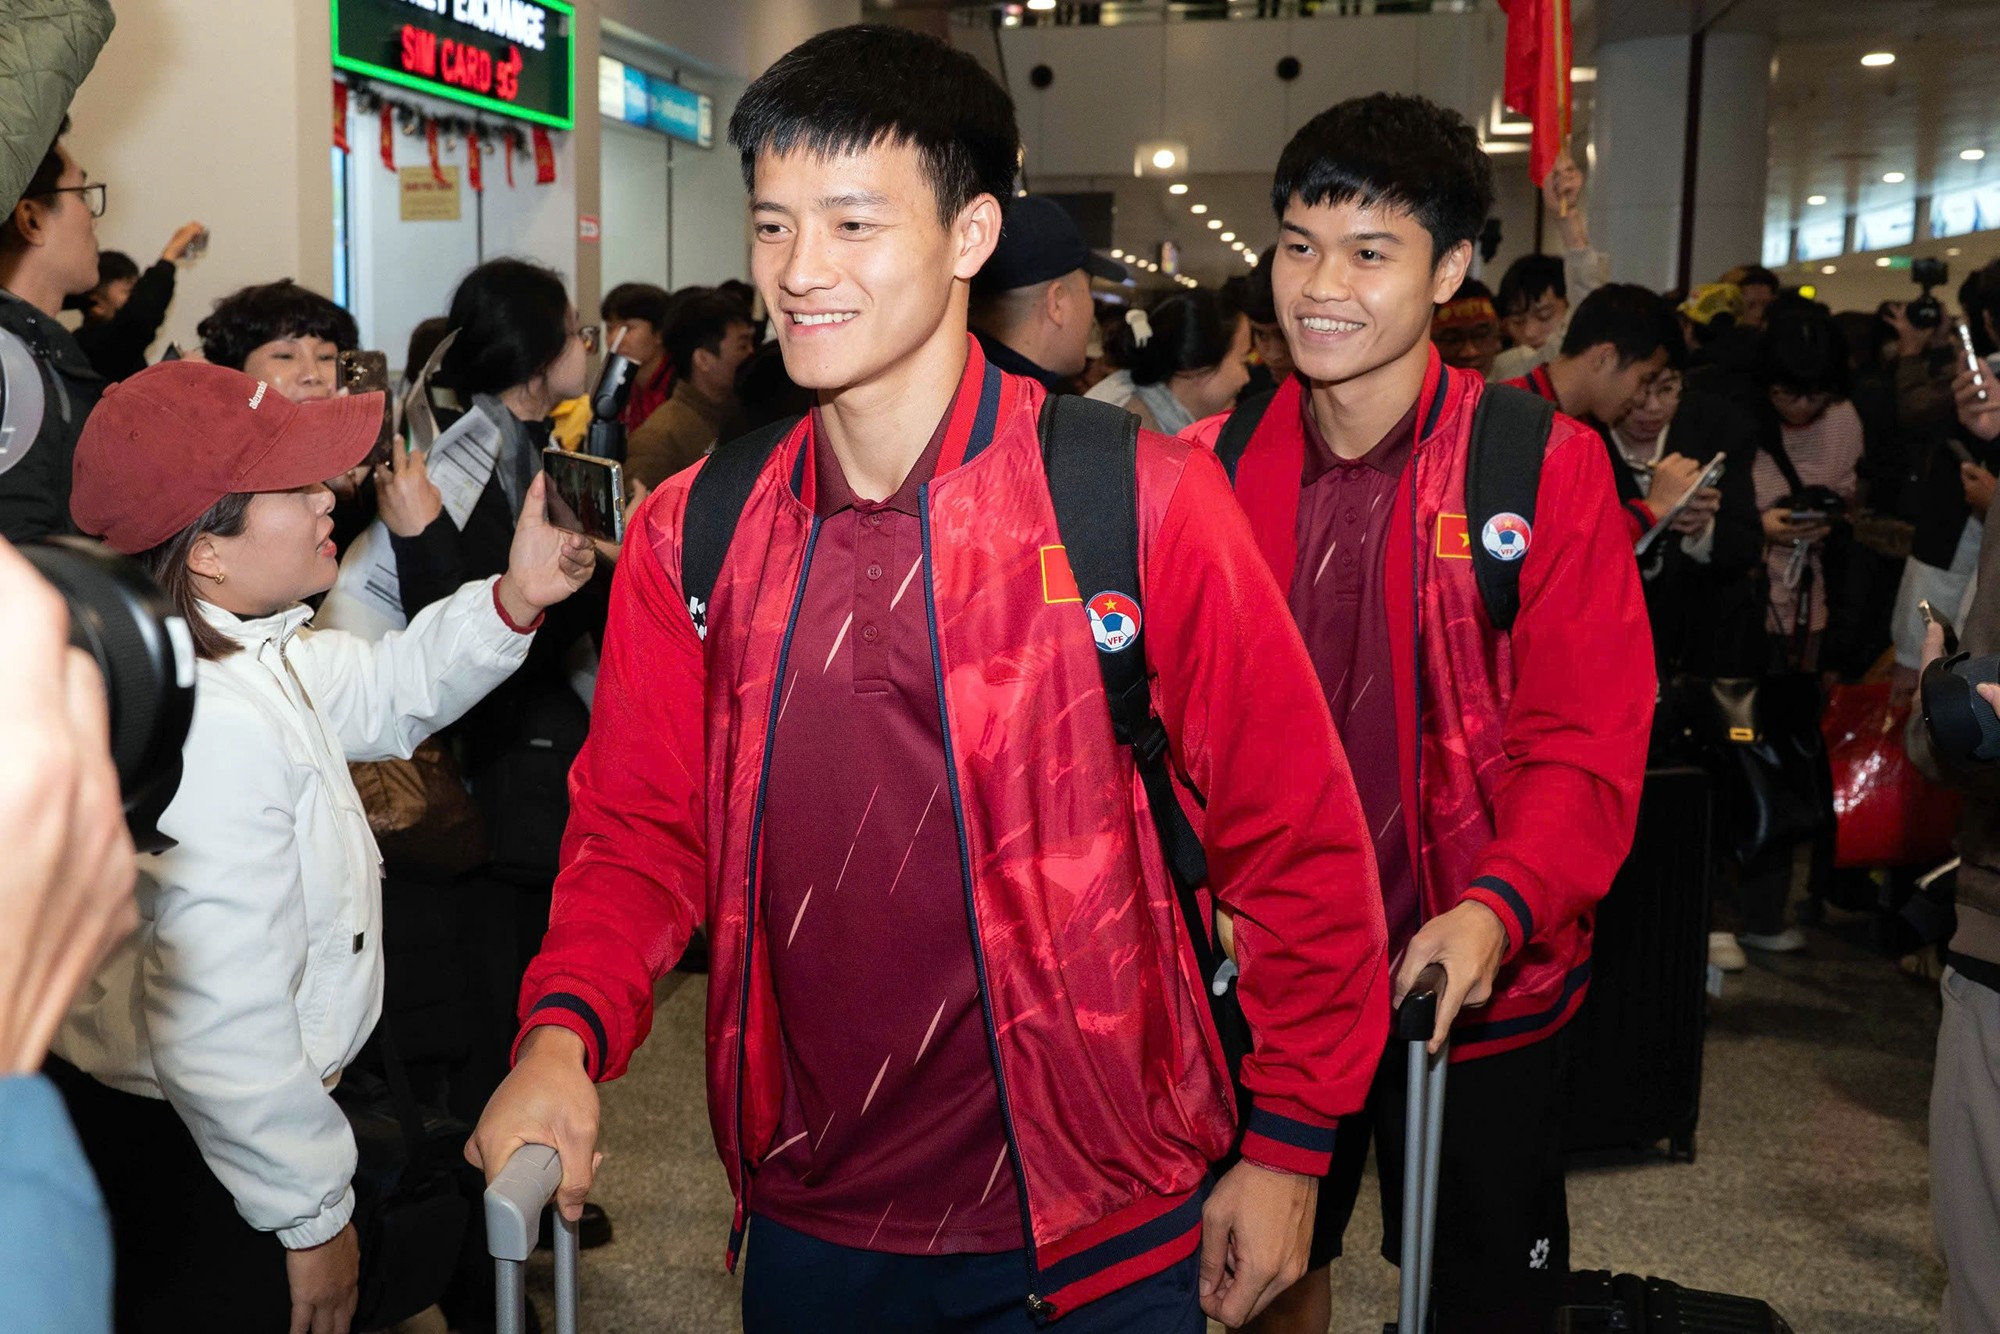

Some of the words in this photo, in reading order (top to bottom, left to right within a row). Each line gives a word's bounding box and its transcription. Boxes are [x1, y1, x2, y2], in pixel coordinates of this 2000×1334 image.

[401, 24, 437, 77] SIM
[440, 39, 493, 93] CARD
[1107, 635, 1124, 645] VFF
